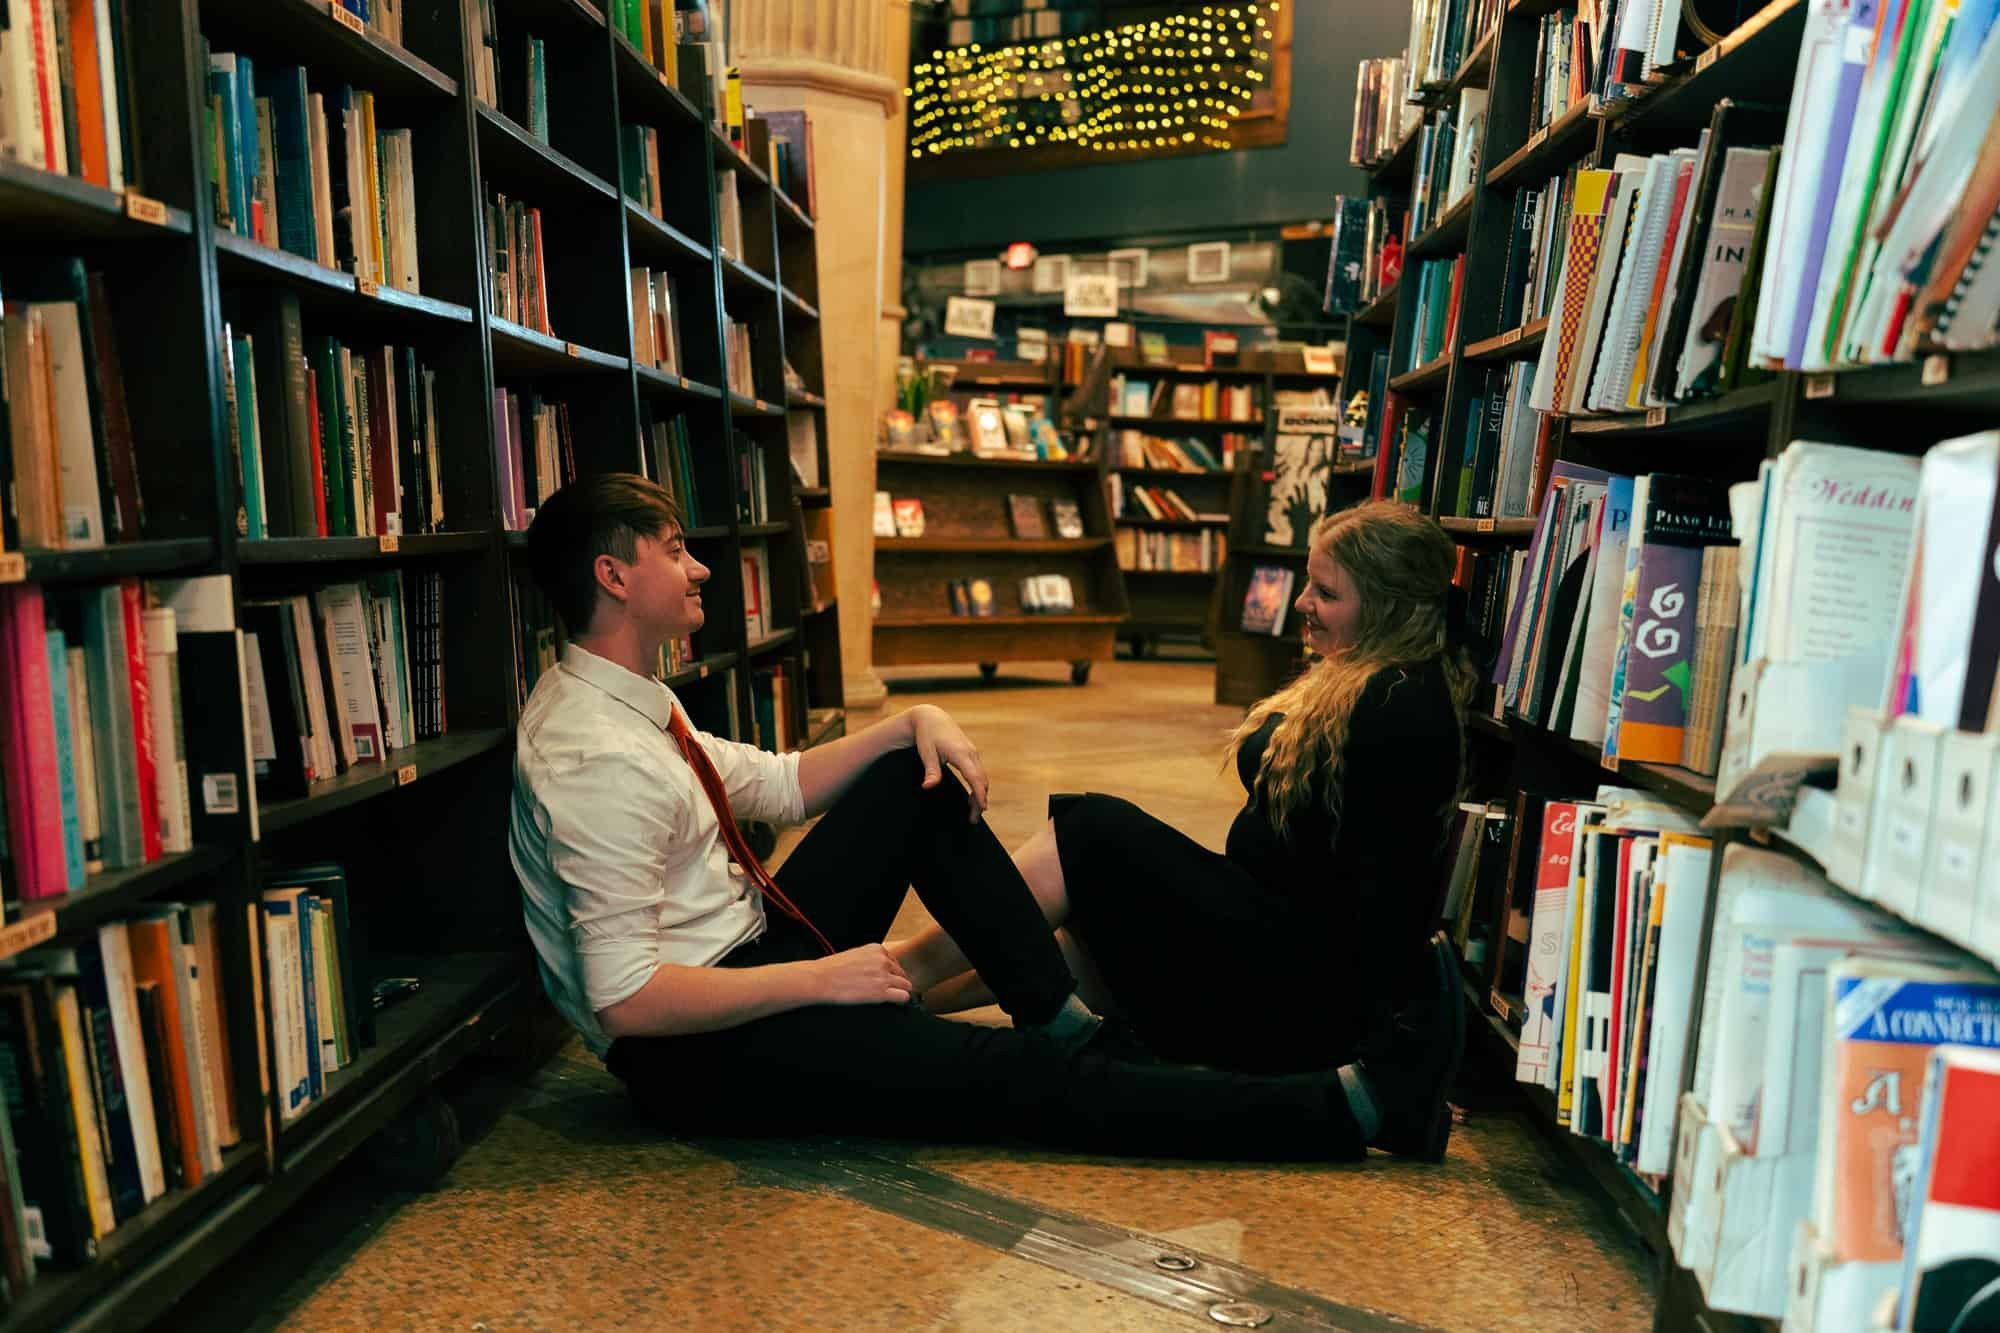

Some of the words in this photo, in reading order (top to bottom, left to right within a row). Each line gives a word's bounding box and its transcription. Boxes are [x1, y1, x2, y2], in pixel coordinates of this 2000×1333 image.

[1715, 245, 1745, 262] IN
[1488, 393, 1505, 432] KURT
[1655, 509, 1700, 526] PIANO
